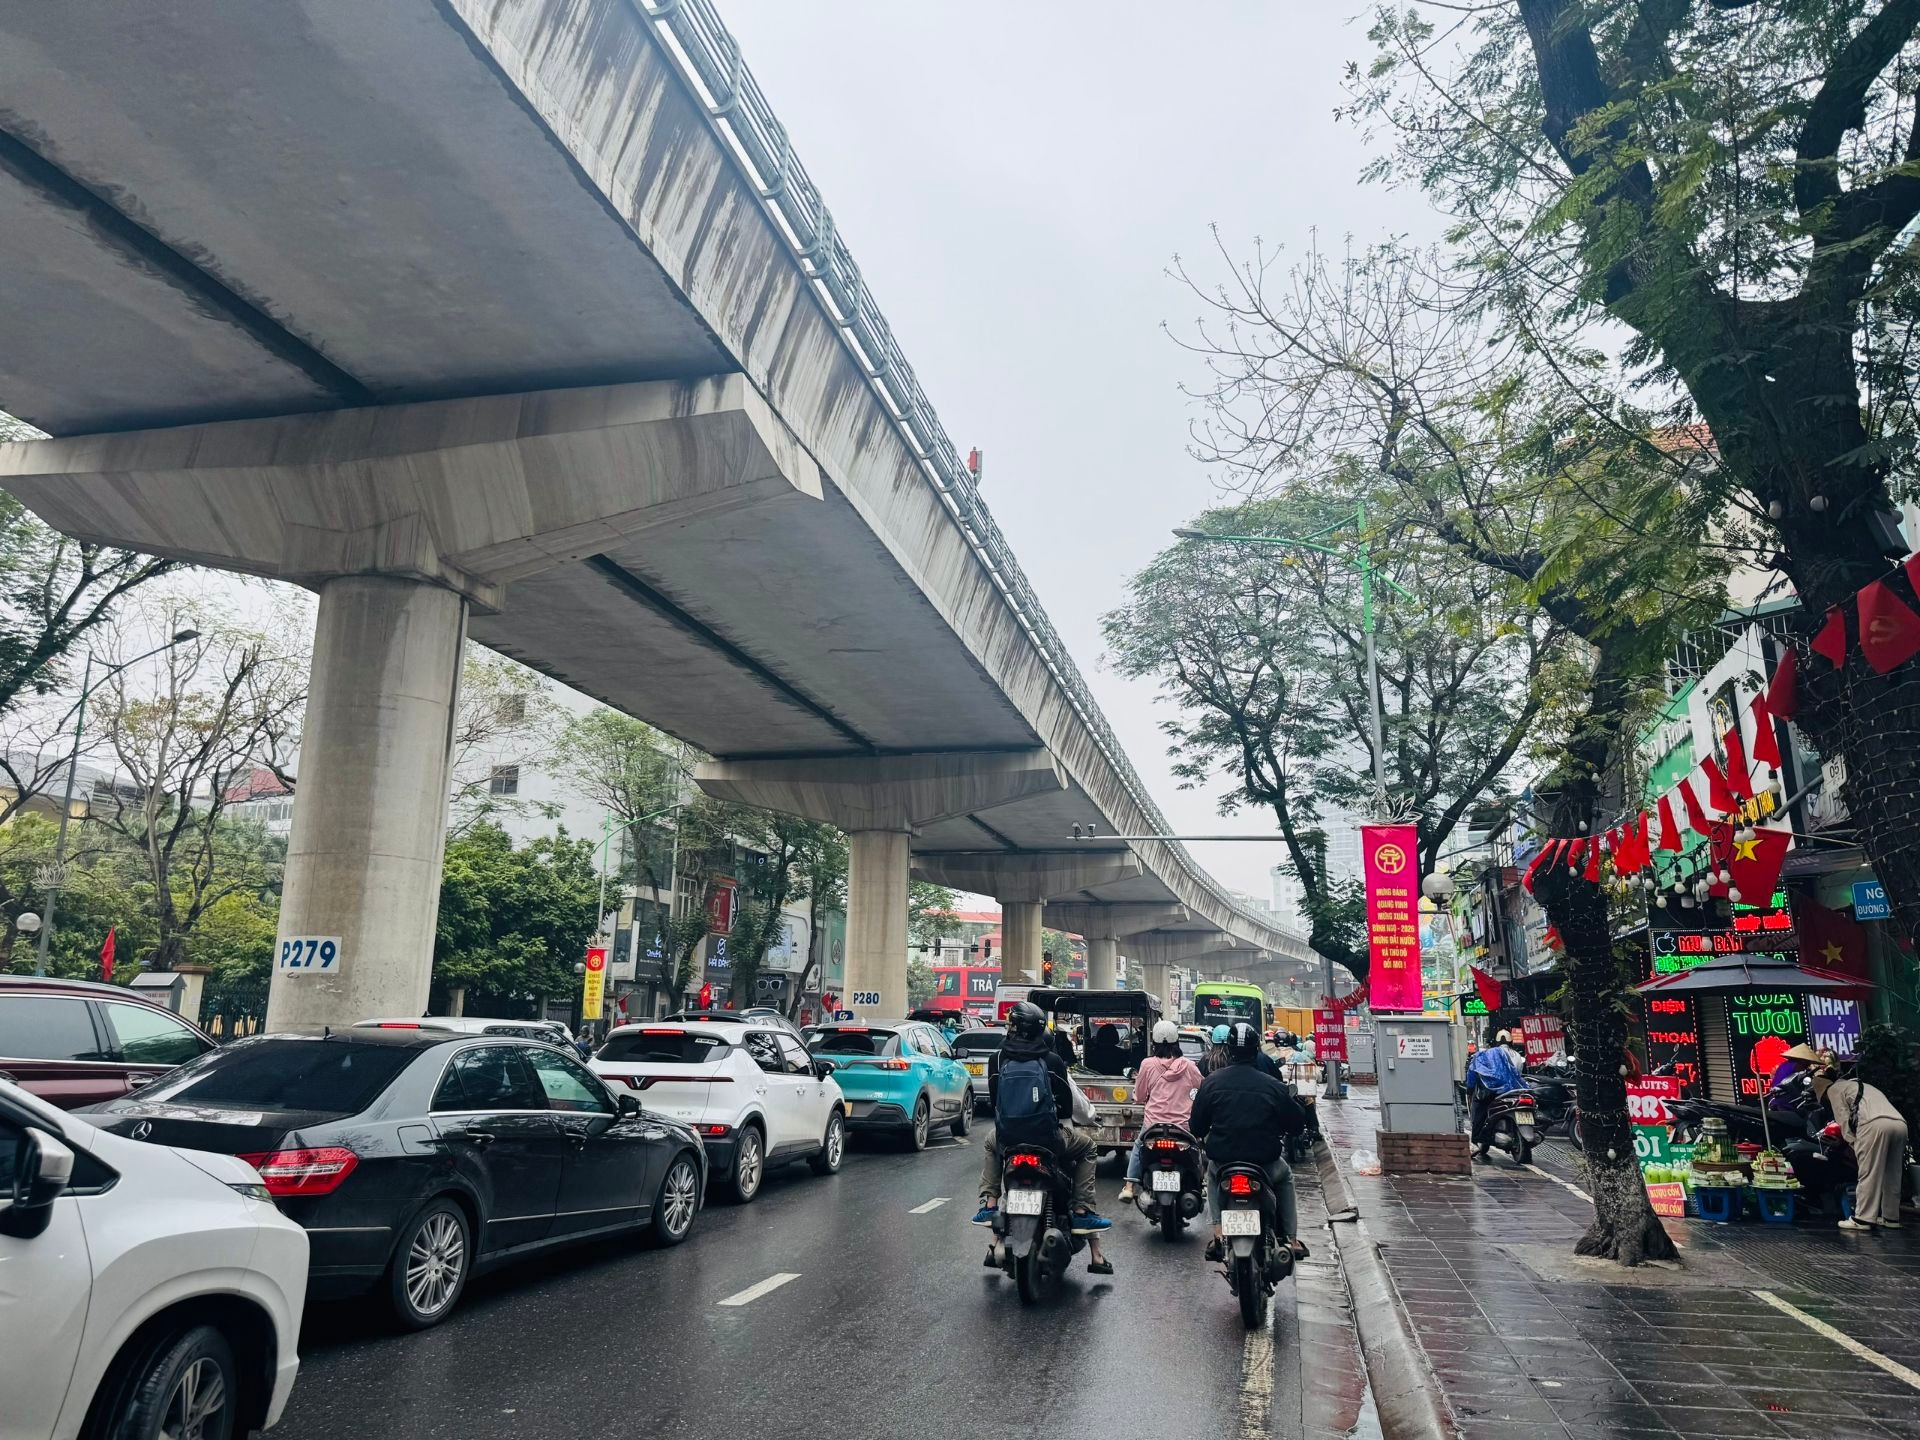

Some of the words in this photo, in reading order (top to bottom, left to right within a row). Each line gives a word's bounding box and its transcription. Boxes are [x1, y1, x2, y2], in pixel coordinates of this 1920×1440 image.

[1866, 887, 1885, 899] NG
[281, 939, 336, 968] P279
[971, 974, 994, 992] TRẢ
[853, 992, 880, 1005] P280
[1651, 998, 1686, 1015] ĐIỆN
[1523, 1018, 1542, 1034] CHO
[1542, 1016, 1563, 1032] THU
[1732, 1008, 1803, 1035] TƯƠI
[1321, 1037, 1340, 1046] LAPTOP
[1526, 1036, 1544, 1055] CỬA
[1545, 1035, 1566, 1054] HÀN
[1650, 1032, 1696, 1046] THOẠI
[1225, 1223, 1258, 1234] 155.94
